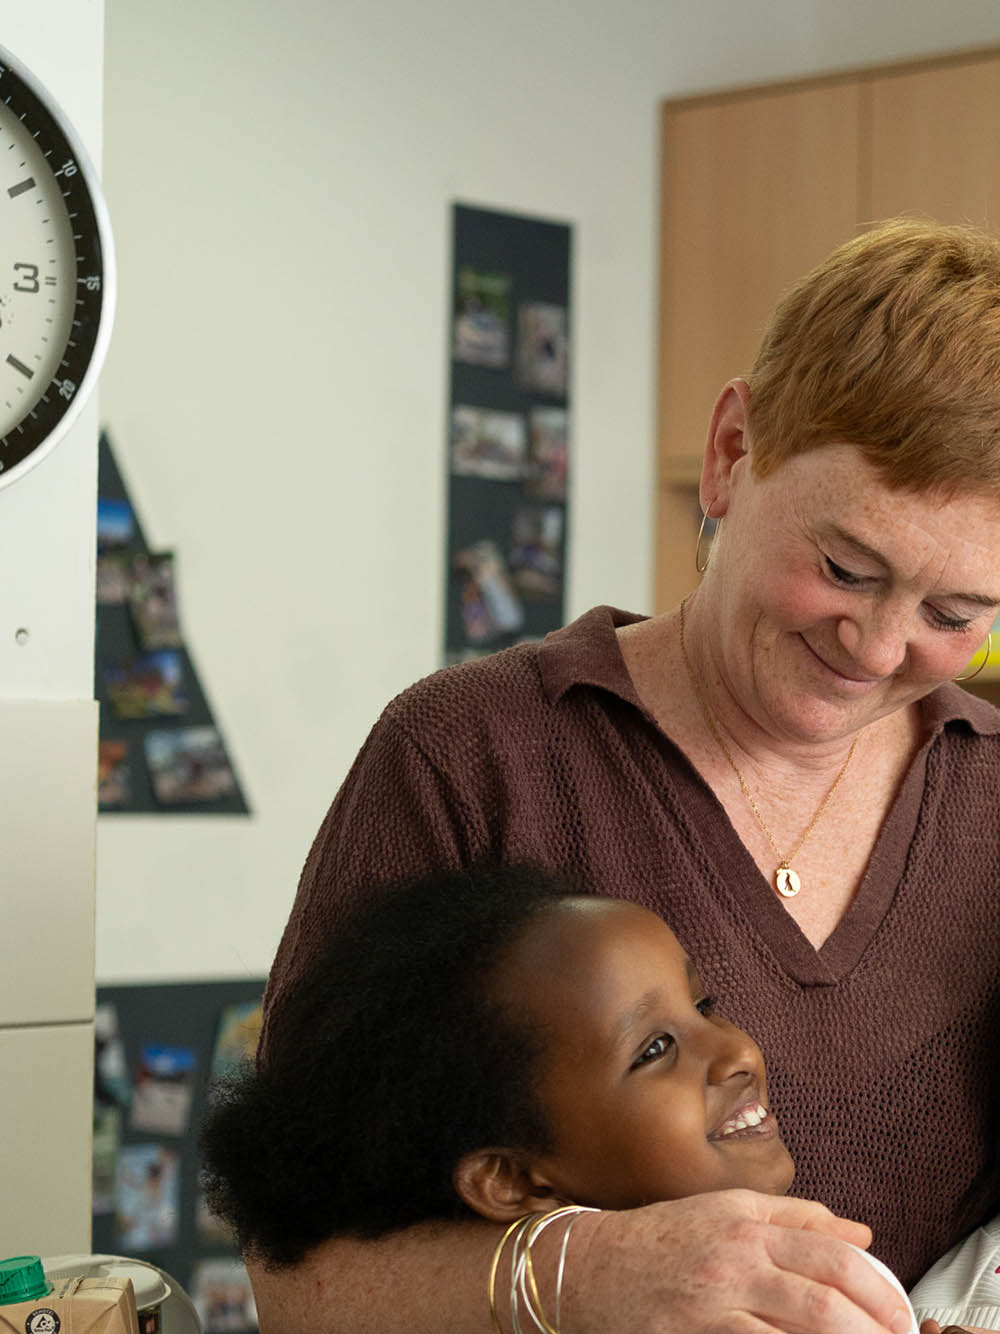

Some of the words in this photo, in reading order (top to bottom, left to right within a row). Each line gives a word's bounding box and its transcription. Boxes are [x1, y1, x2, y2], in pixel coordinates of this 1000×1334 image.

[62, 159, 78, 178] 10
[13, 262, 40, 294] 3
[86, 275, 101, 292] 15
[59, 378, 77, 401] 20
